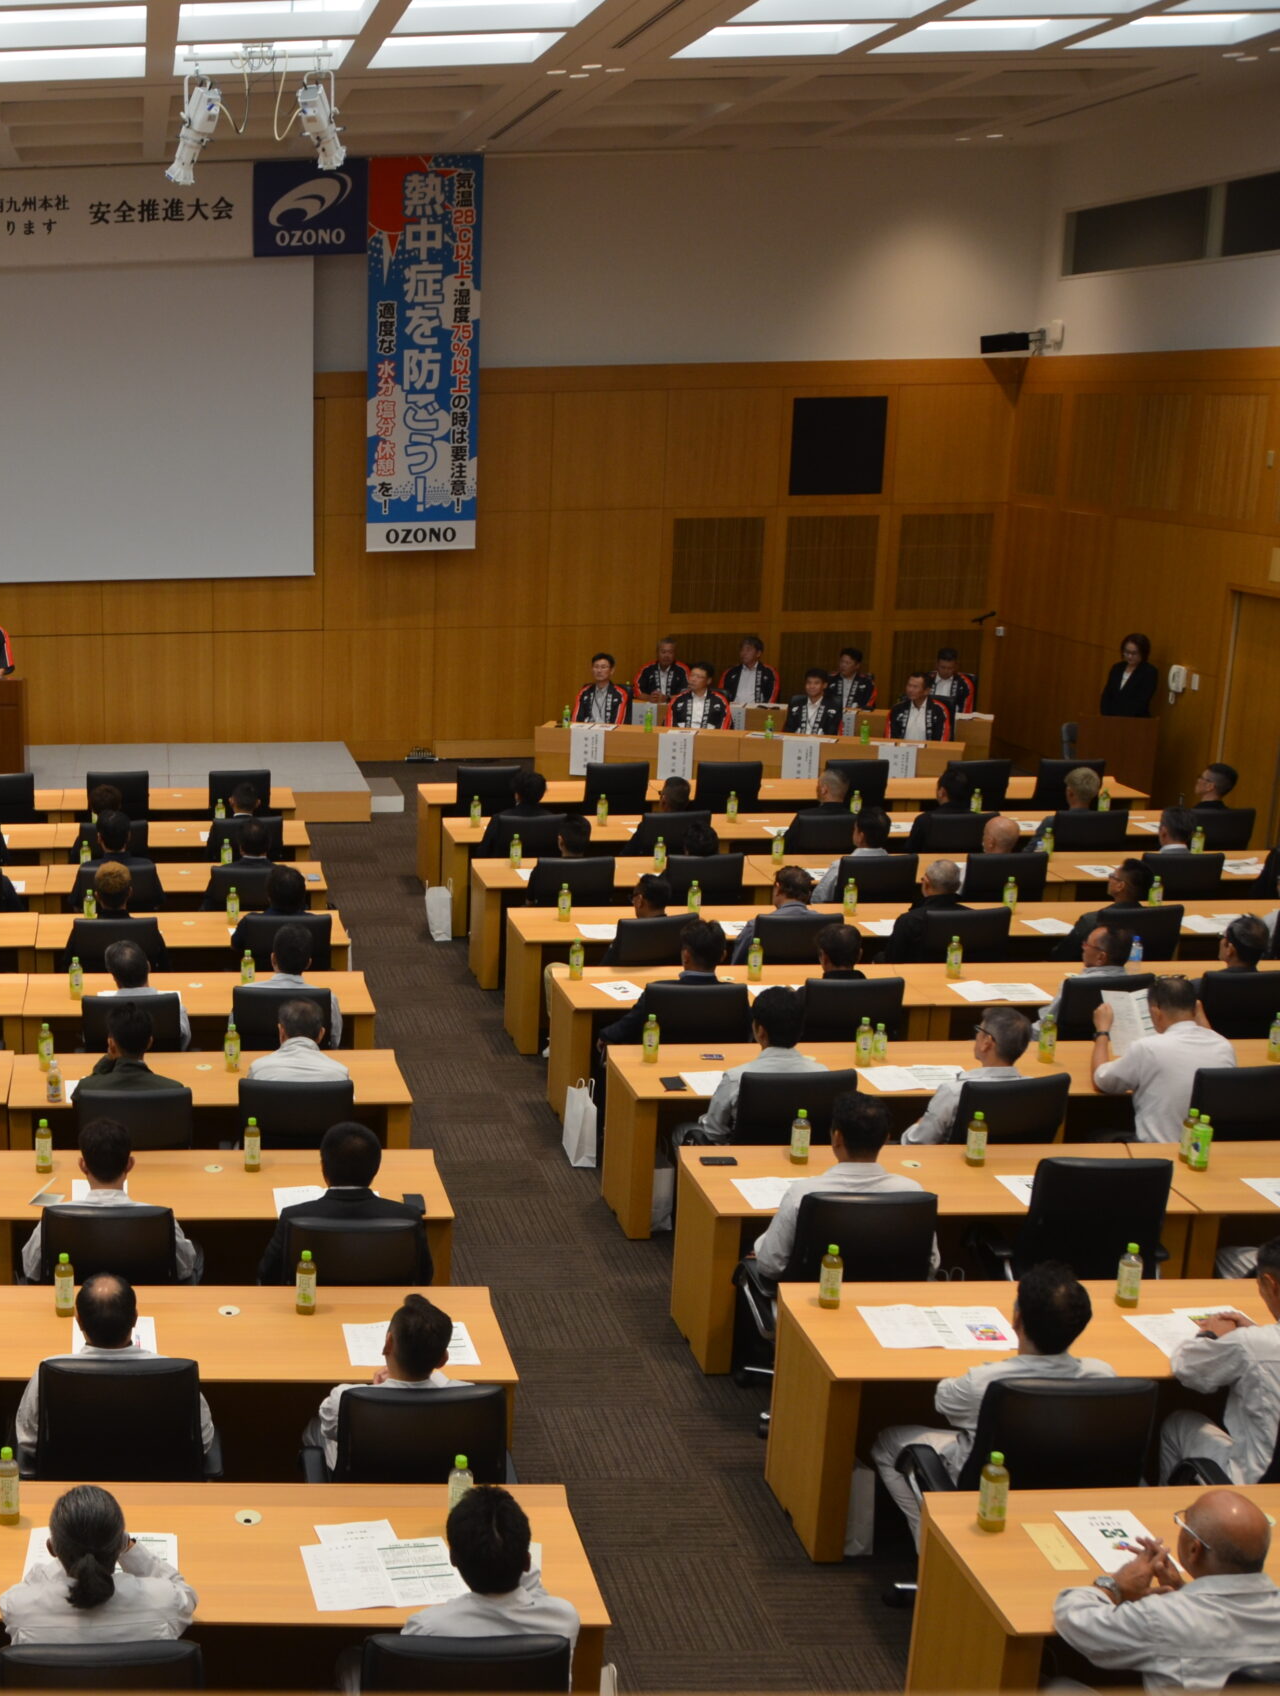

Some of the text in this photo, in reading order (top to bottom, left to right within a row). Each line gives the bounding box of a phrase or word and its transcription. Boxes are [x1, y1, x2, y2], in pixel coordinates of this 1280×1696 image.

[88, 196, 235, 226] 安全推進大会
[275, 228, 347, 247] OZONO
[402, 172, 445, 513] 熱中症を防ごう!
[385, 526, 457, 544] OZONO
